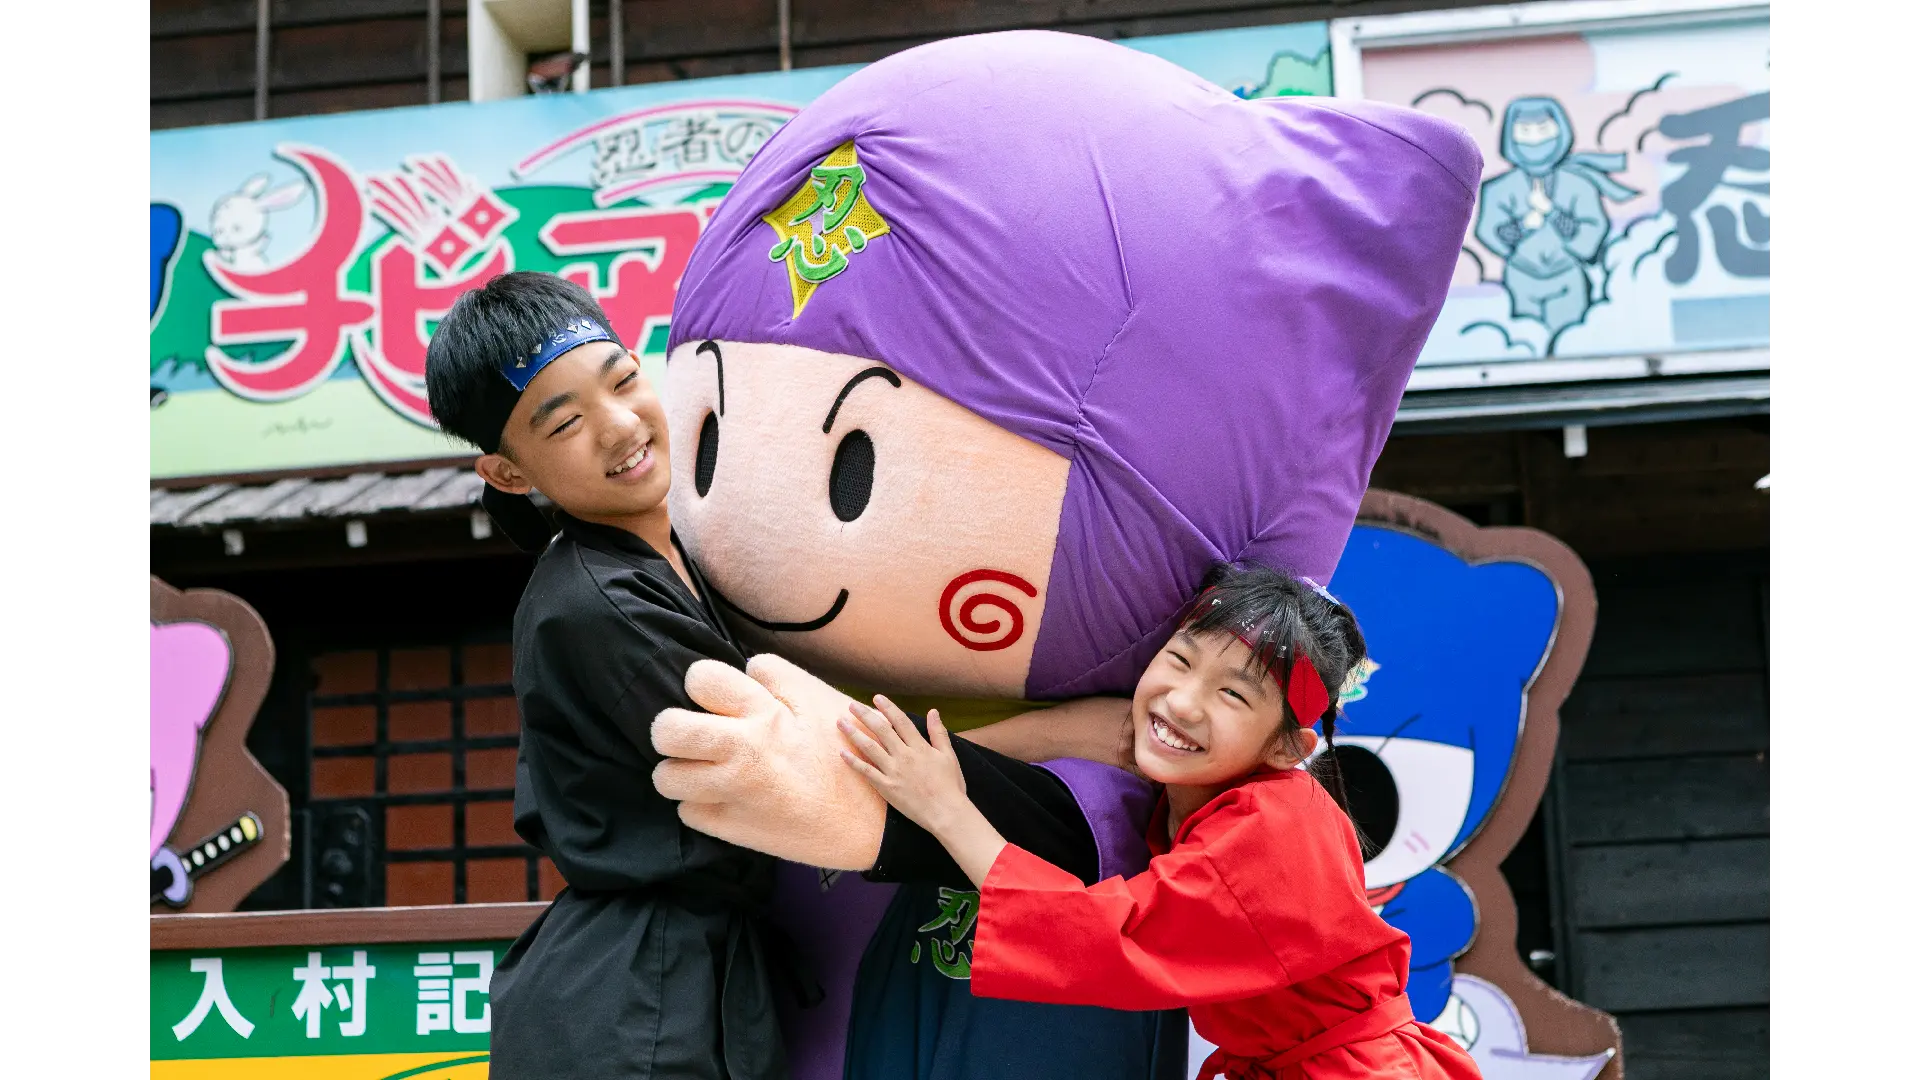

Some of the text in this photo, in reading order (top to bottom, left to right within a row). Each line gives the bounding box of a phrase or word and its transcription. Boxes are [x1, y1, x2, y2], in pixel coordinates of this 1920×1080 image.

[594, 118, 773, 188] 忍者の
[769, 163, 866, 283] 忍
[911, 886, 980, 980] 忍
[171, 950, 494, 1042] 入村記
